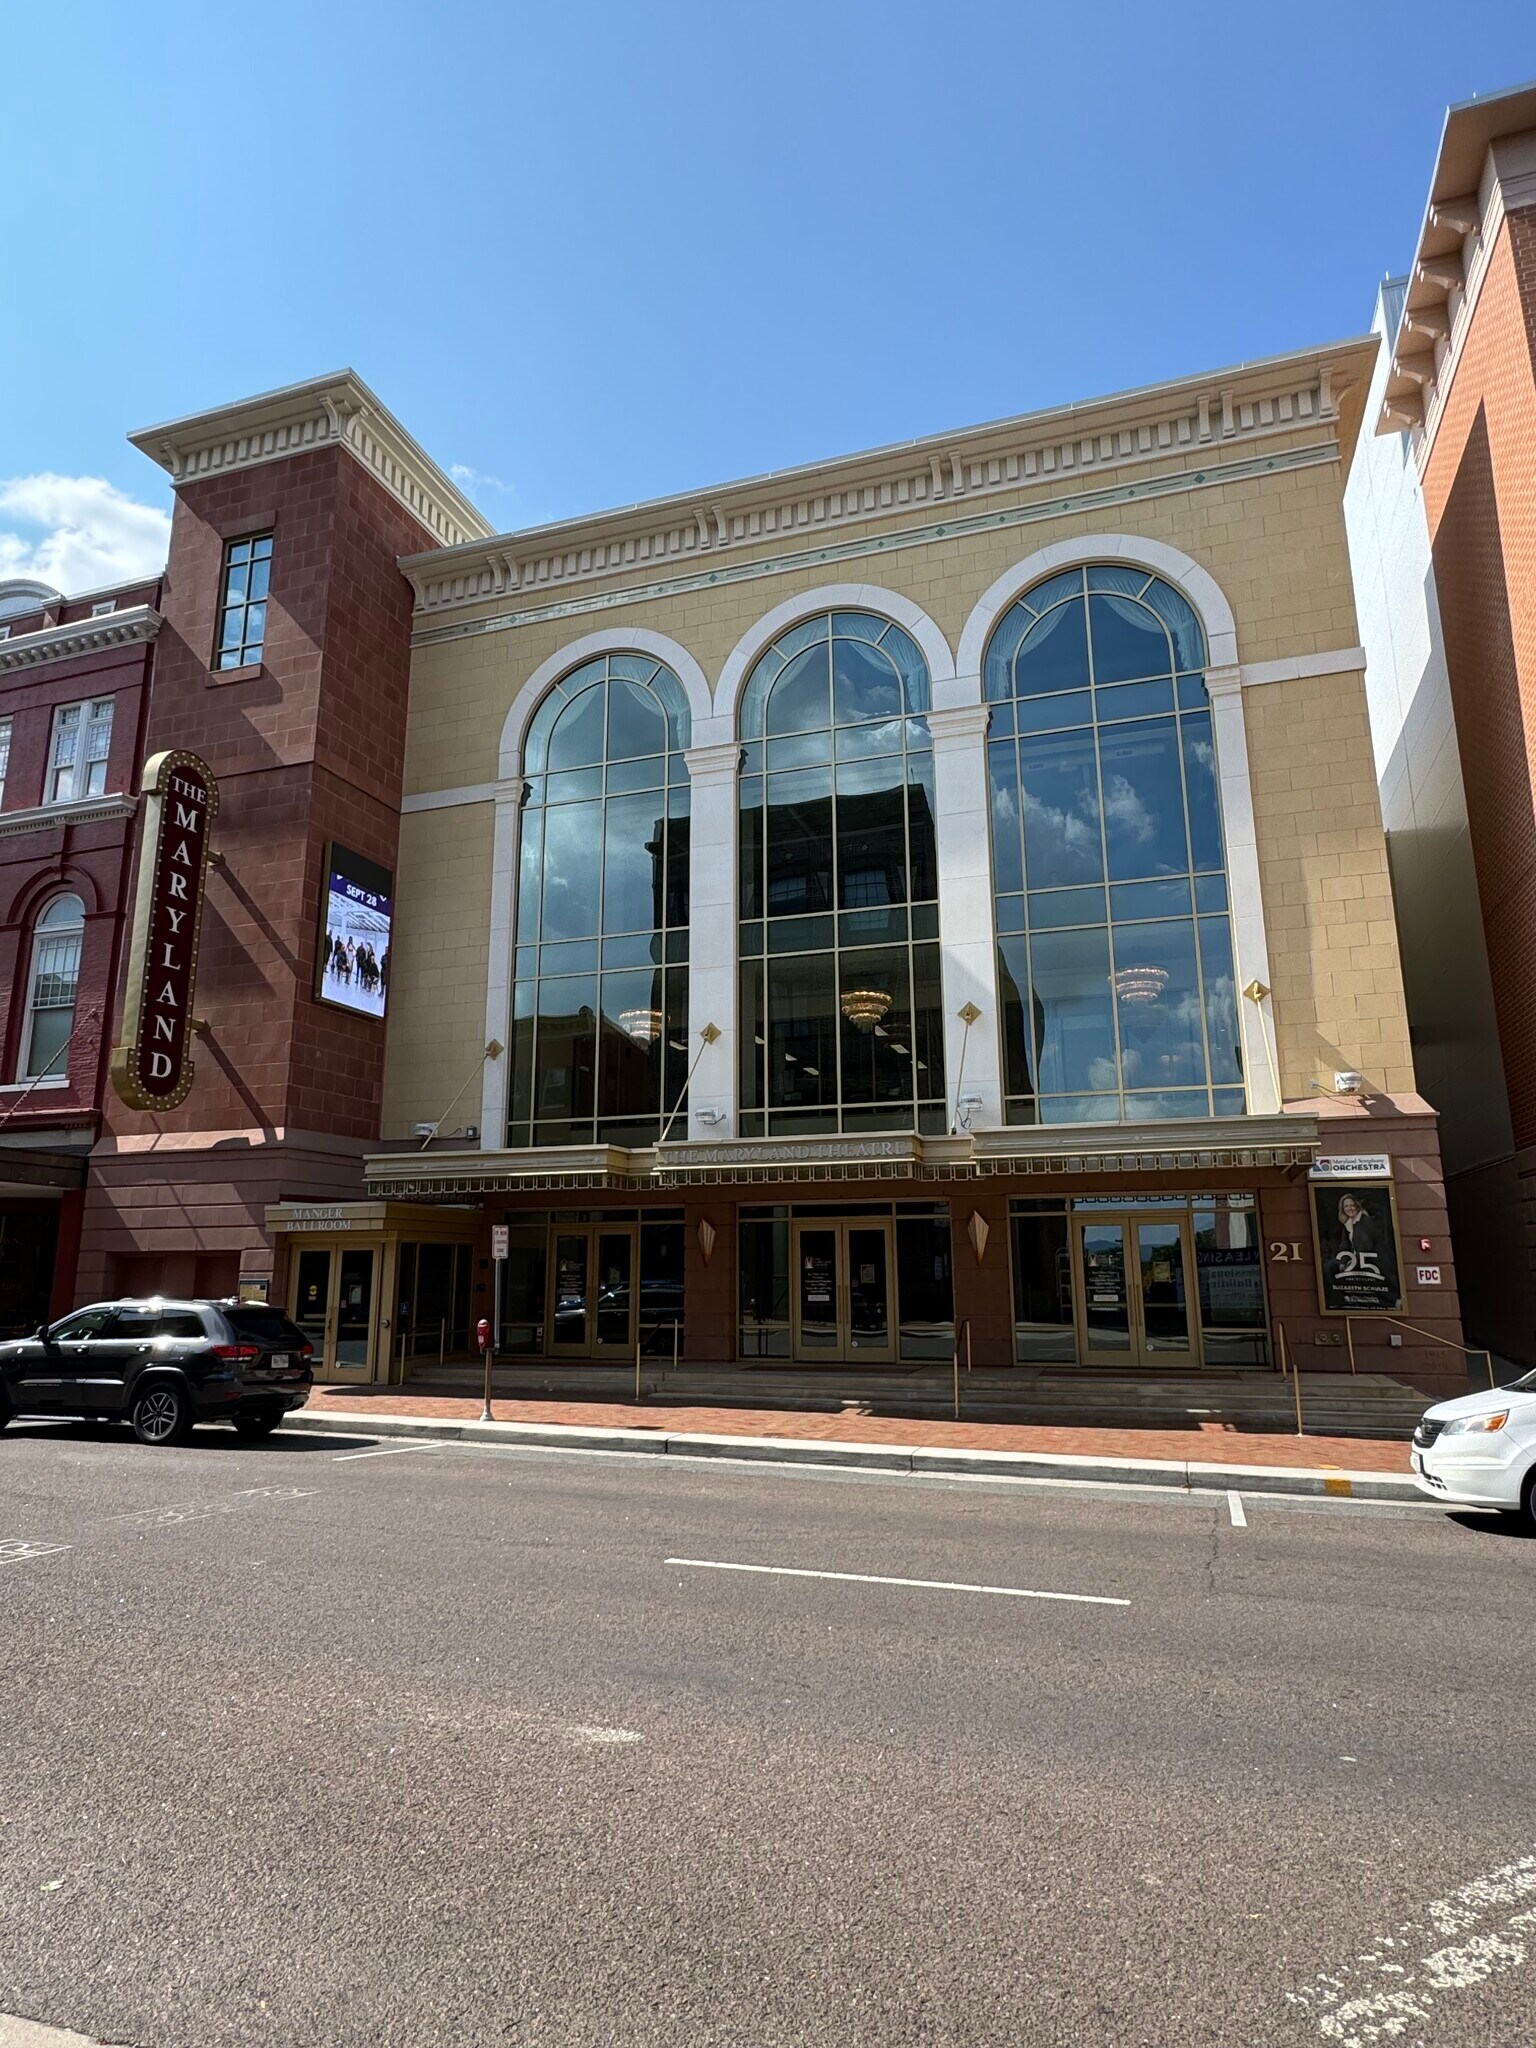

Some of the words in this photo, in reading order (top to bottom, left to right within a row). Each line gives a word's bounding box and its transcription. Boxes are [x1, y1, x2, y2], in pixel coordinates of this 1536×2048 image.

[171, 775, 206, 805] THE
[346, 884, 366, 901] SEPT
[366, 893, 378, 907] 28
[149, 801, 199, 1079] MARYLAND
[663, 1151, 698, 1164] THE
[703, 1145, 811, 1163] MARYLAND
[815, 1141, 907, 1158] THEATRE
[1332, 1163, 1386, 1171] ORCHESTRA
[292, 1208, 343, 1219] MANGER
[286, 1220, 351, 1231] BALLROOM
[1270, 1242, 1303, 1263] 21
[1335, 1250, 1383, 1274] 25
[1419, 1269, 1439, 1281] FDC
